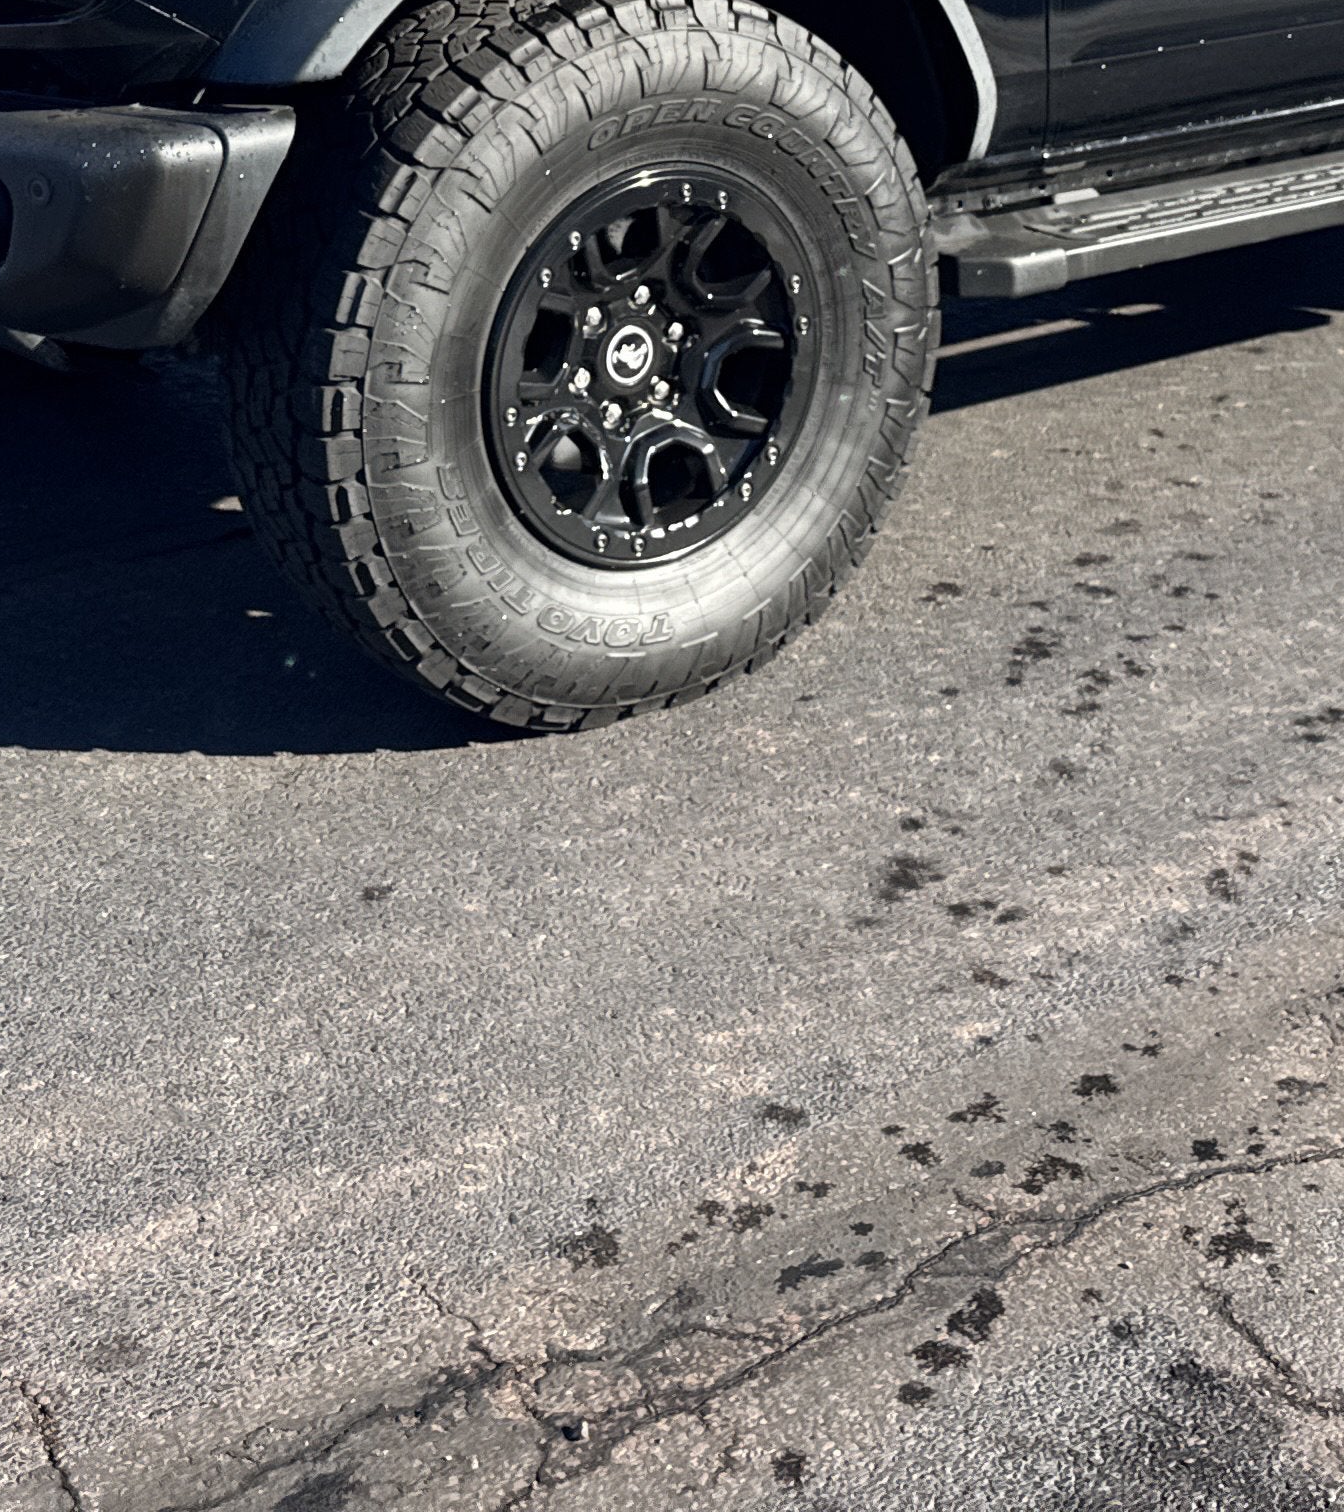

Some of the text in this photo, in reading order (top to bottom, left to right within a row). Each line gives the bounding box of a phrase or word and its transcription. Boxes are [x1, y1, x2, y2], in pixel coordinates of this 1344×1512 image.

[587, 98, 722, 152] OPEN
[722, 103, 878, 261] COUNTRY
[436, 464, 675, 648] TOYO TIRES
